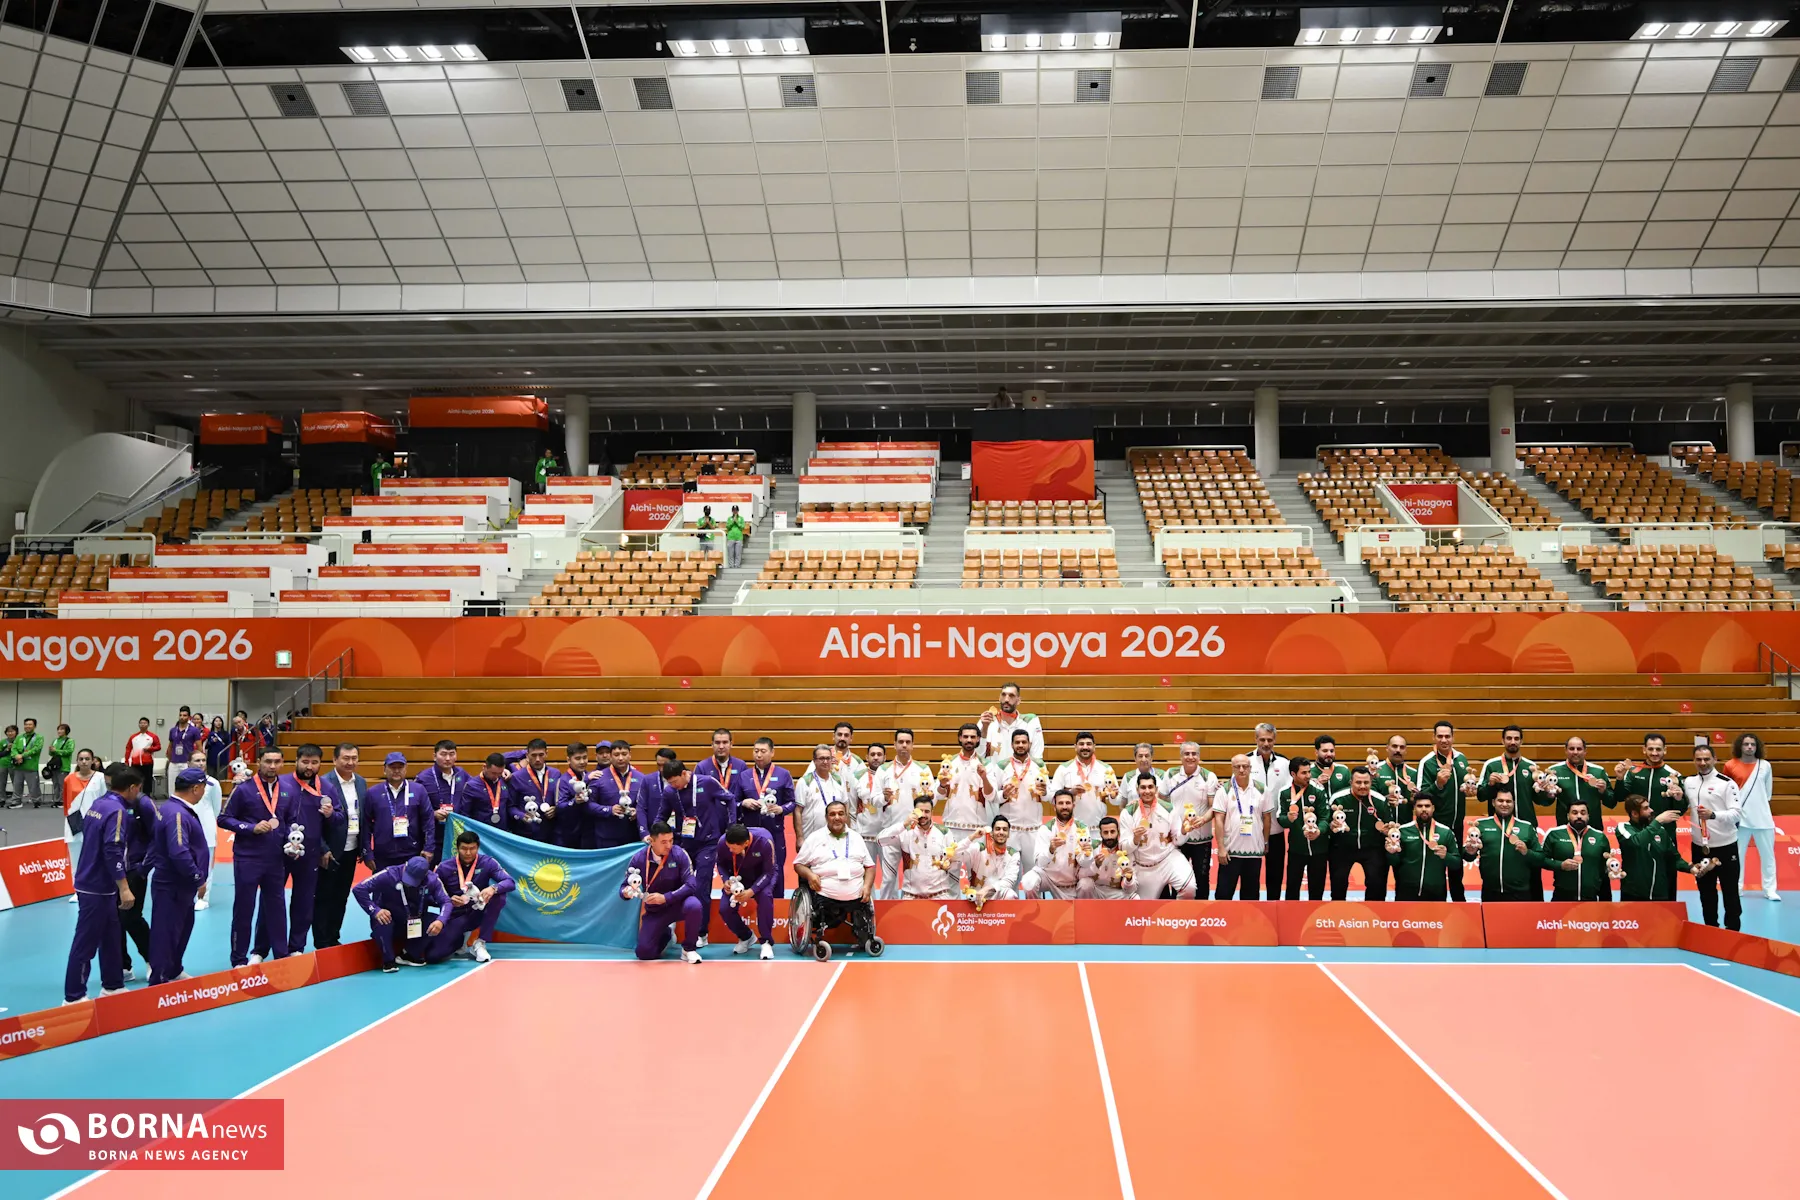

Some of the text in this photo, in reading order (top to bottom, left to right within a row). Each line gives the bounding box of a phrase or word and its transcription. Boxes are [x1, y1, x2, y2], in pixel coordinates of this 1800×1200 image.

[629, 504, 681, 514] Aichi-Nago
[1409, 507, 1433, 516] 2026
[648, 512, 671, 521] 2026
[152, 628, 254, 661] 2026
[820, 623, 1226, 668] Aichi-Nagoya 2026
[41, 870, 66, 884] 2026
[957, 918, 1005, 926] Aichi-Nagoya
[1125, 917, 1227, 930] Aichi-Nagoya 2026
[1316, 918, 1444, 929] 5th Asian Para Games
[1537, 919, 1639, 932] Aichi-Nagoya 2026
[157, 973, 269, 1009] Aichi-Nagoya 2026
[0, 1025, 46, 1046] ames
